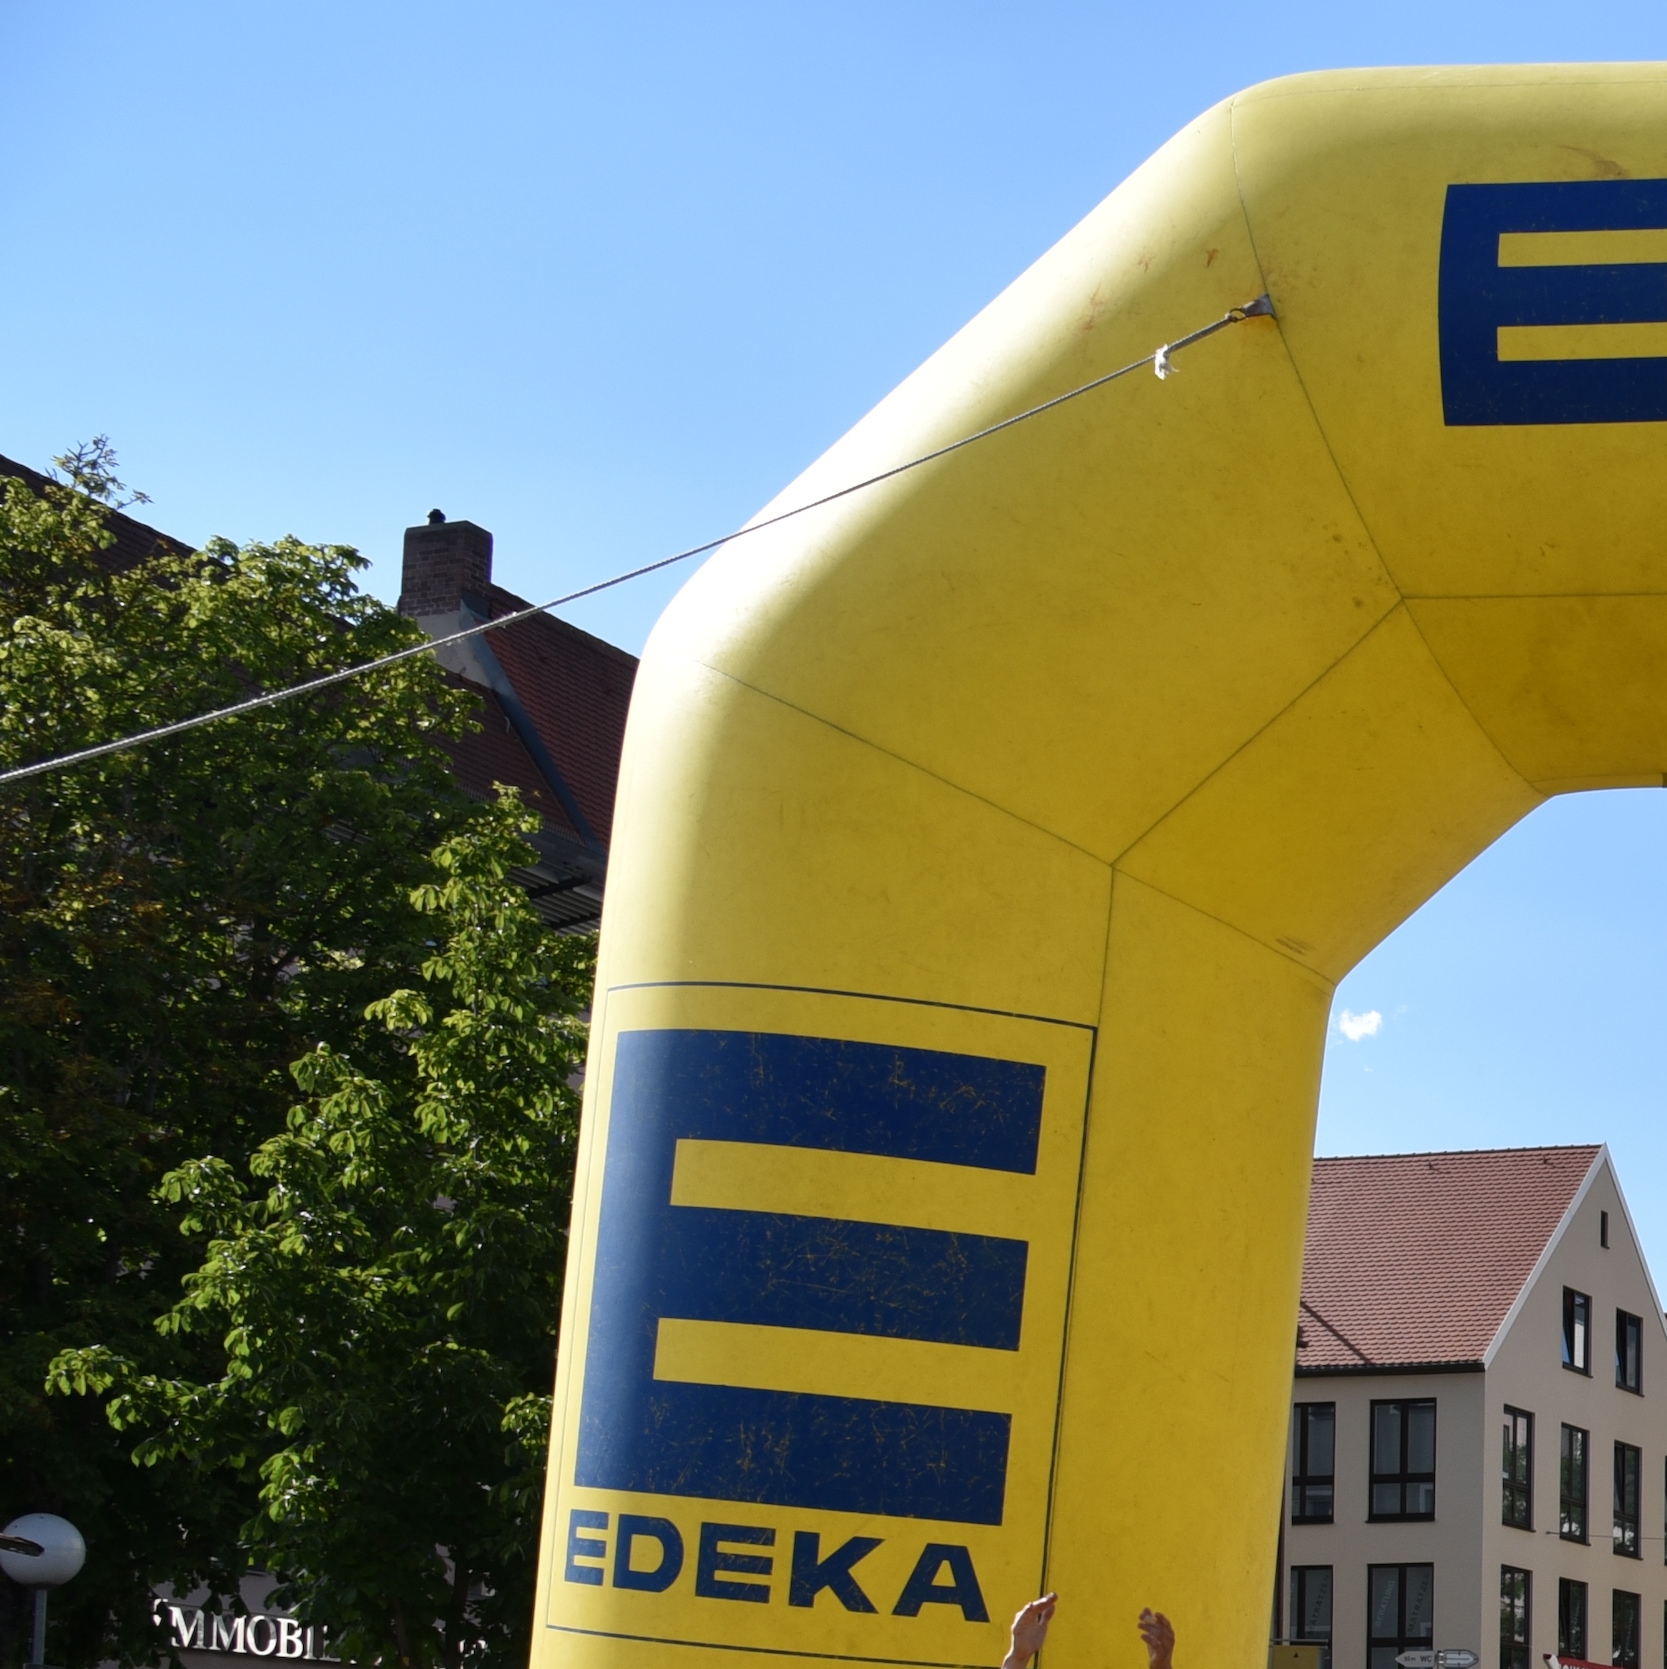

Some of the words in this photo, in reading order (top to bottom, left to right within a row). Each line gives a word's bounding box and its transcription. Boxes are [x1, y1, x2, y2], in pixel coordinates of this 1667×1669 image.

[574, 1029, 1047, 1526] E
[564, 1509, 990, 1622] EDEKA
[1420, 1655, 1432, 1663] WC
